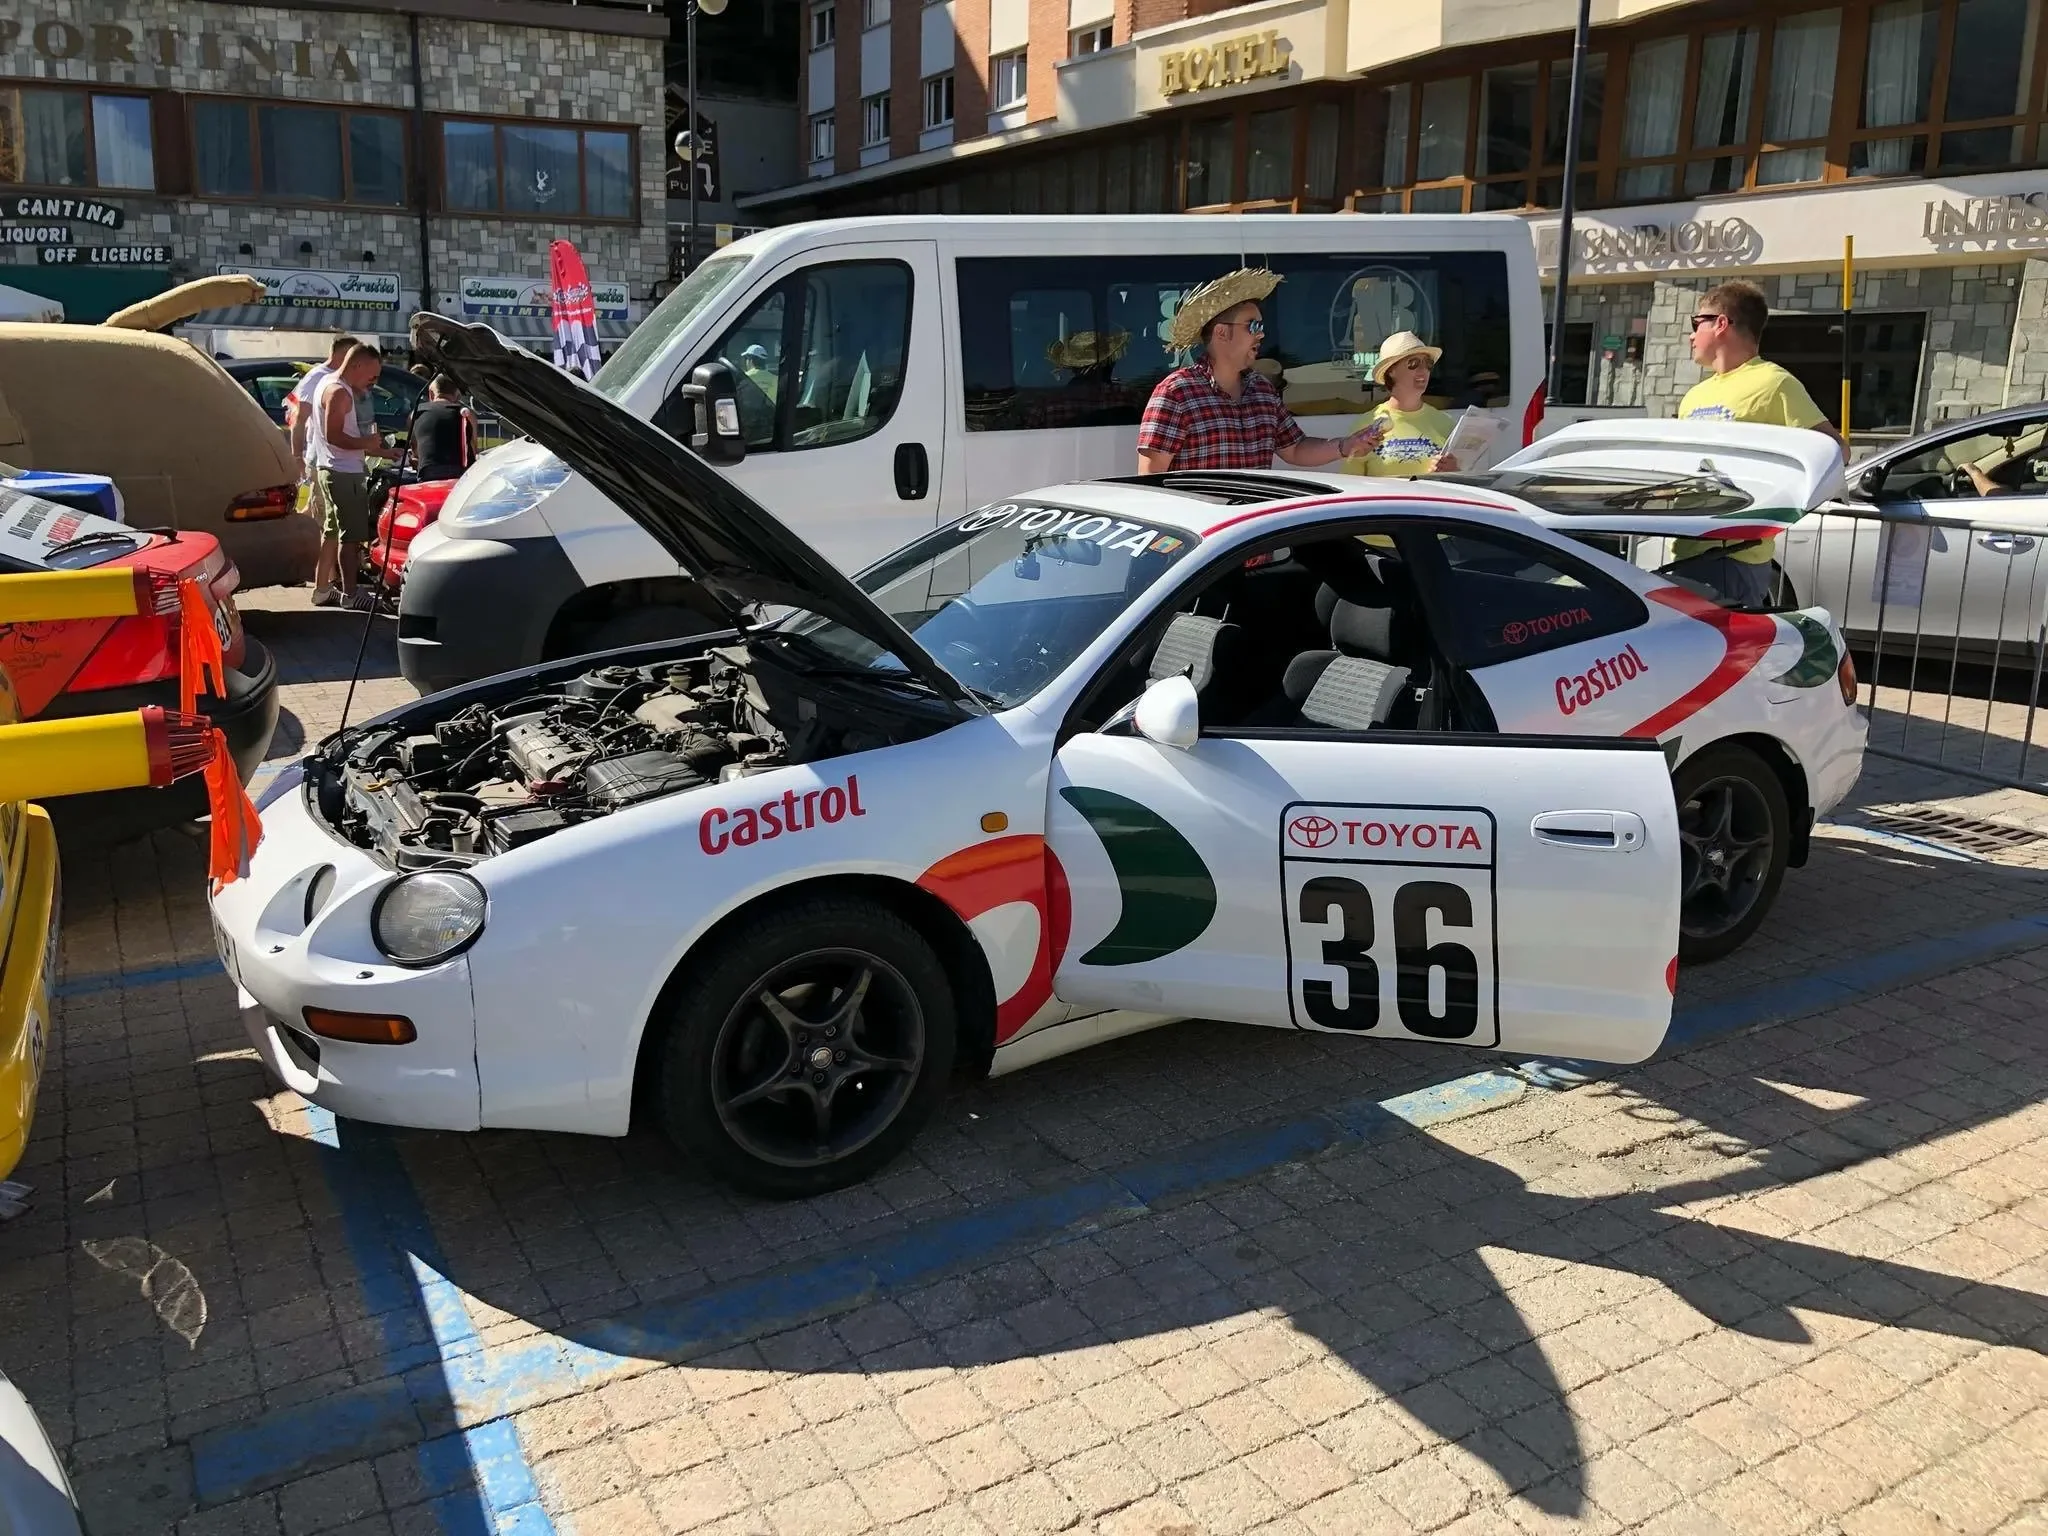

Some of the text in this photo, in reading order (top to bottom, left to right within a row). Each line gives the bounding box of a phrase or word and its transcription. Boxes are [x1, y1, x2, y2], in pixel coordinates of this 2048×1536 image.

[1158, 29, 1291, 95] HOTEL
[17, 199, 117, 227] CANTINA
[44, 248, 77, 263] OFF
[1582, 217, 1748, 261] SANPAOLO
[340, 275, 395, 294] Frutta
[292, 298, 395, 311] ORTOFRUTTICOLI
[1001, 506, 1160, 558] TOYOTA
[1527, 607, 1593, 636] TOYOTA
[1554, 643, 1649, 716] Castrol
[698, 774, 867, 856] Castrol
[1342, 821, 1482, 850] TOYOTA
[1299, 875, 1479, 1039] 36
